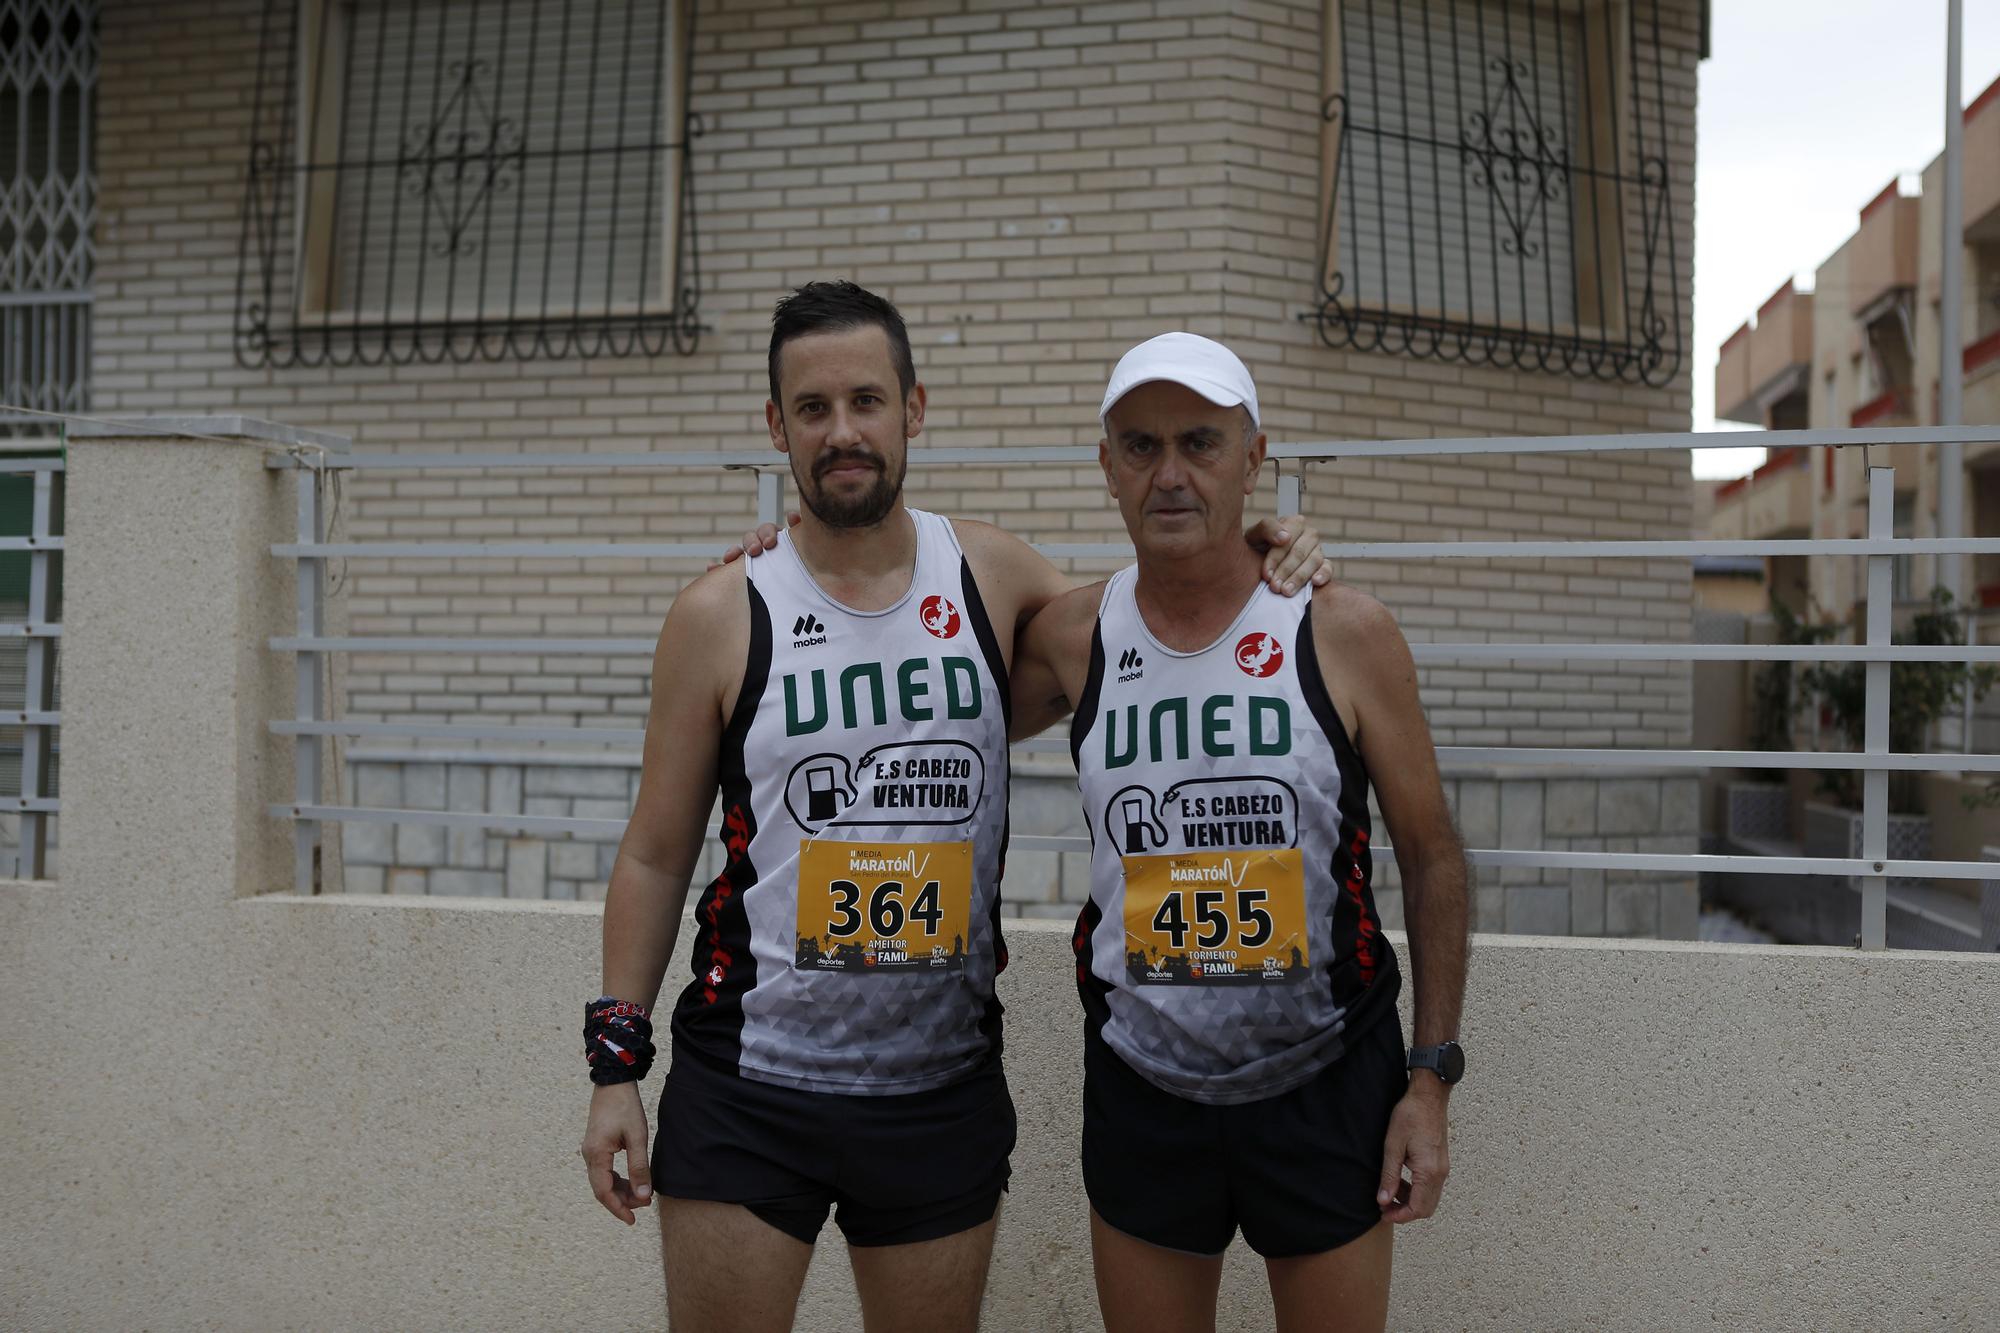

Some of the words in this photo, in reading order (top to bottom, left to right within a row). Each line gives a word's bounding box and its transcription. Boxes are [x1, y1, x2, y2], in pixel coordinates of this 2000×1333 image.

[793, 635, 827, 649] mobel
[1118, 670, 1143, 684] mobel
[782, 656, 983, 737] UNED
[1105, 694, 1292, 770] UNED
[875, 760, 900, 780] E.S
[905, 759, 971, 780] CABEZO
[873, 784, 969, 809] VENTURA
[1181, 798, 1206, 818] E.S
[1211, 794, 1283, 817] CABEZO
[1182, 821, 1286, 848] VENTURA
[850, 857, 910, 872] MARATÓN
[1176, 859, 1199, 867] MEDIA
[1171, 865, 1227, 881] MARATÓN
[827, 880, 944, 938] 364
[1152, 889, 1274, 949] 455
[868, 940, 907, 949] AMEITOR
[817, 957, 845, 966] deportes
[877, 951, 908, 962] FAMU
[1189, 951, 1238, 960] TORMENTO
[1146, 970, 1173, 979] deportes
[1203, 962, 1236, 974] FAMU
